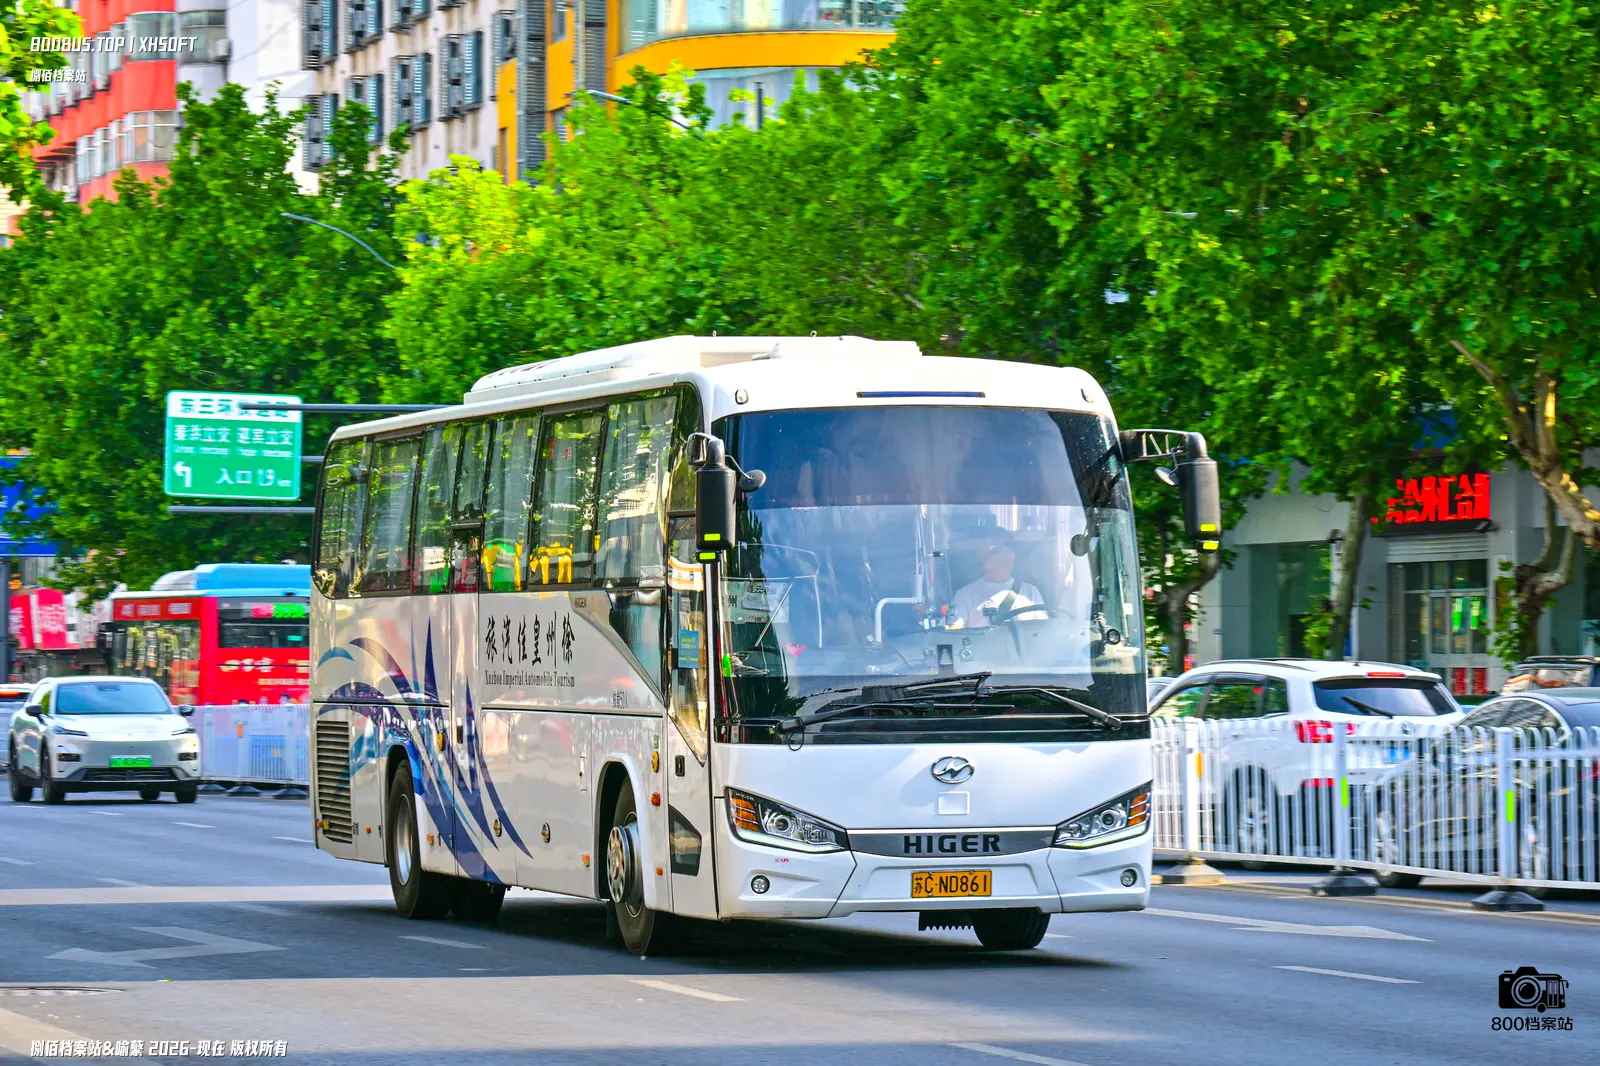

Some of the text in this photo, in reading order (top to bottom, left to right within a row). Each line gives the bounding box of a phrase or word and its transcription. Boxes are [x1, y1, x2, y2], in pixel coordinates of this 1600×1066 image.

[215, 468, 253, 485] 入口
[574, 597, 588, 608] HIGER
[484, 670, 575, 689] Xuzhou Imperial Automobile Tourism
[903, 834, 1000, 854] HIGER
